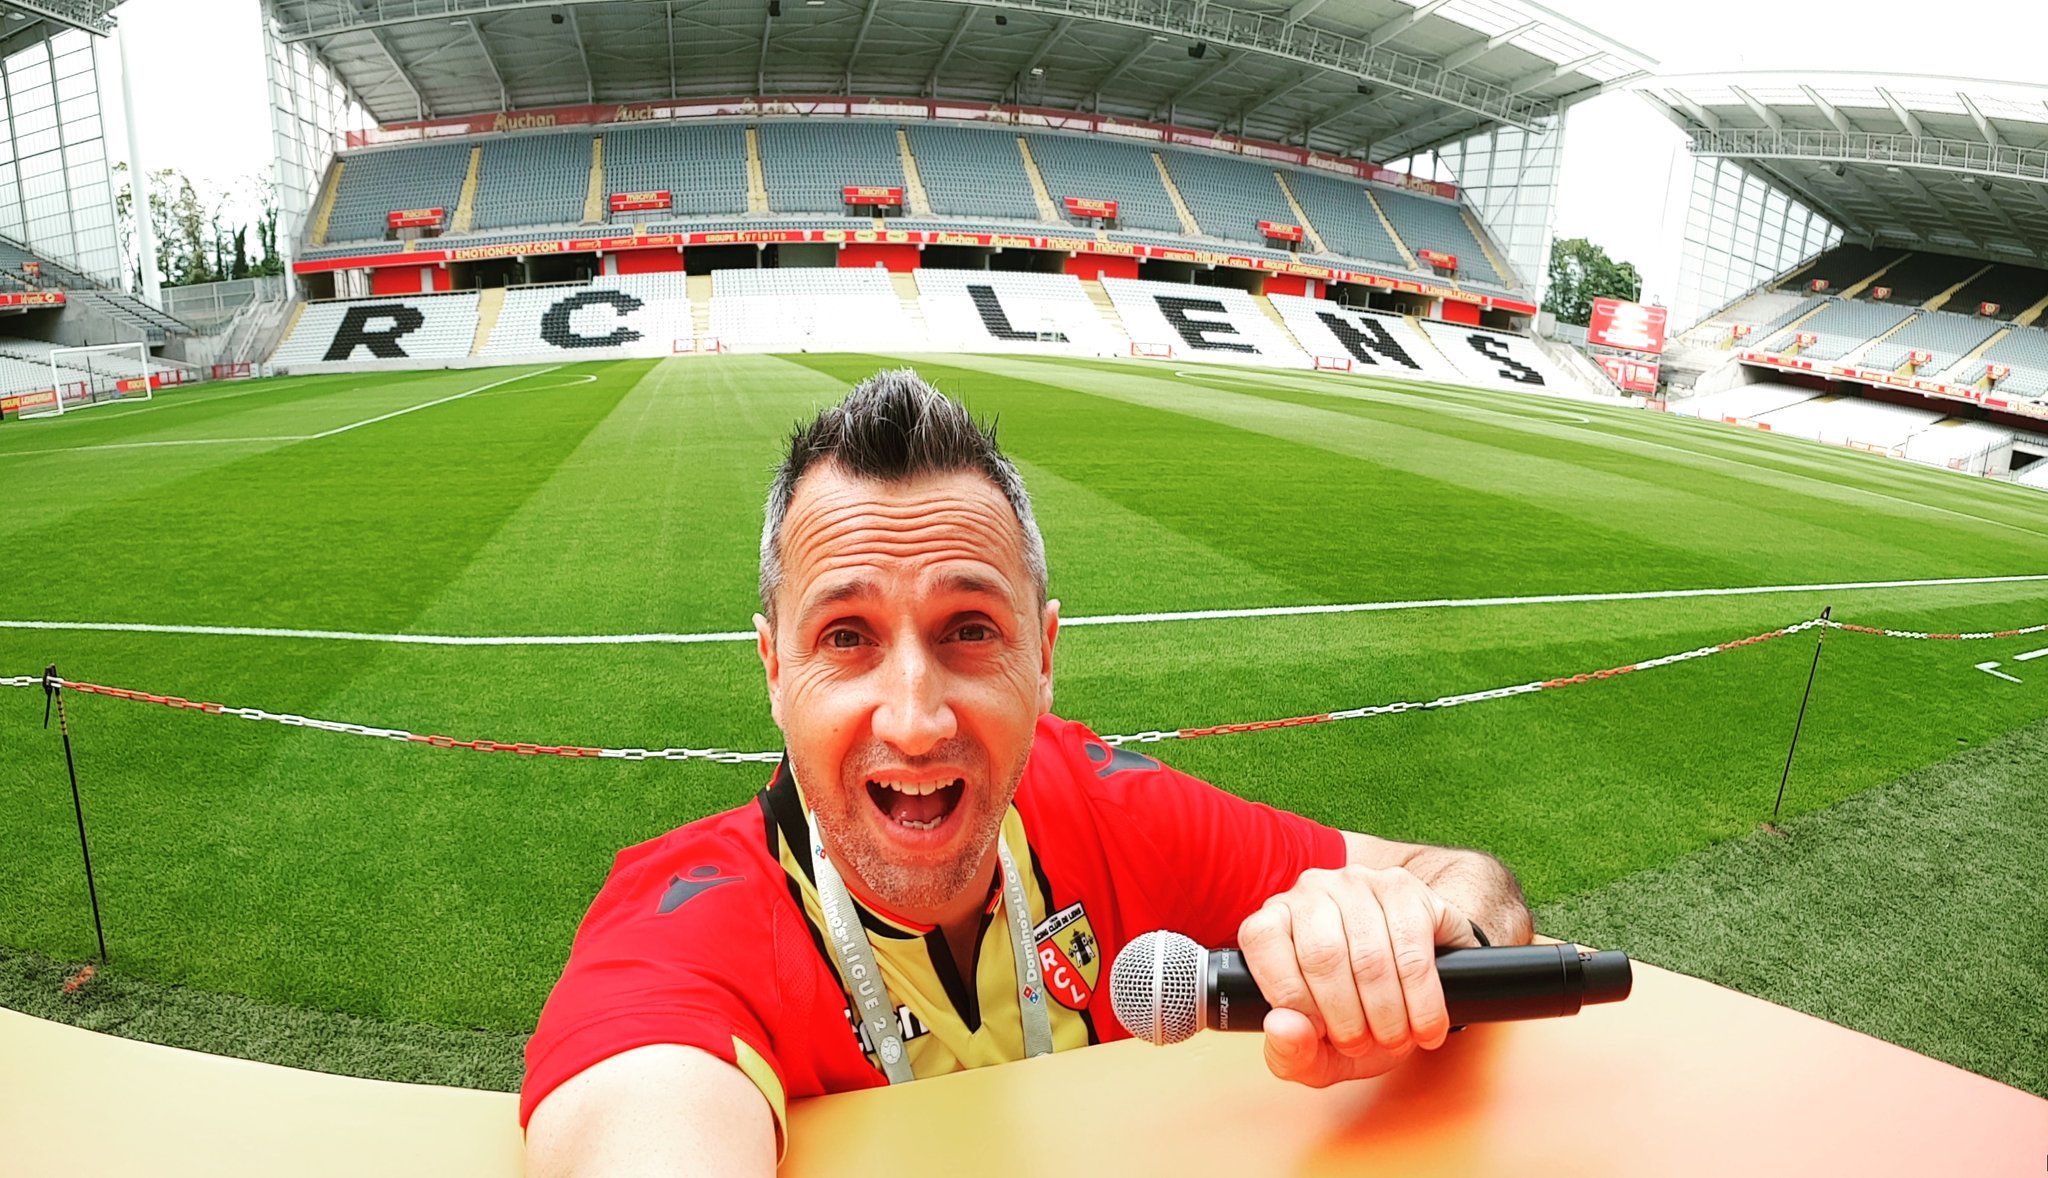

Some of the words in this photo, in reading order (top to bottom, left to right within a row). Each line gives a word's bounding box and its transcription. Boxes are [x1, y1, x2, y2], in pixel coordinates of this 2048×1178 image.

[493, 112, 556, 131] Auchan
[936, 232, 978, 245] Auchan
[989, 235, 1031, 248] Auchan
[1047, 237, 1088, 251] macron
[1094, 241, 1134, 254] macron
[455, 242, 559, 260] EMOTIONFOOT.COM
[1034, 929, 1049, 942] ACING
[1048, 919, 1062, 933] CLUB
[1061, 914, 1070, 925] DE
[1068, 906, 1083, 921] LENS
[1017, 910, 1038, 983] Domino's
[841, 942, 880, 1010] LIGUE
[872, 1016, 888, 1033] 2
[1220, 995, 1229, 1030] SHURE
